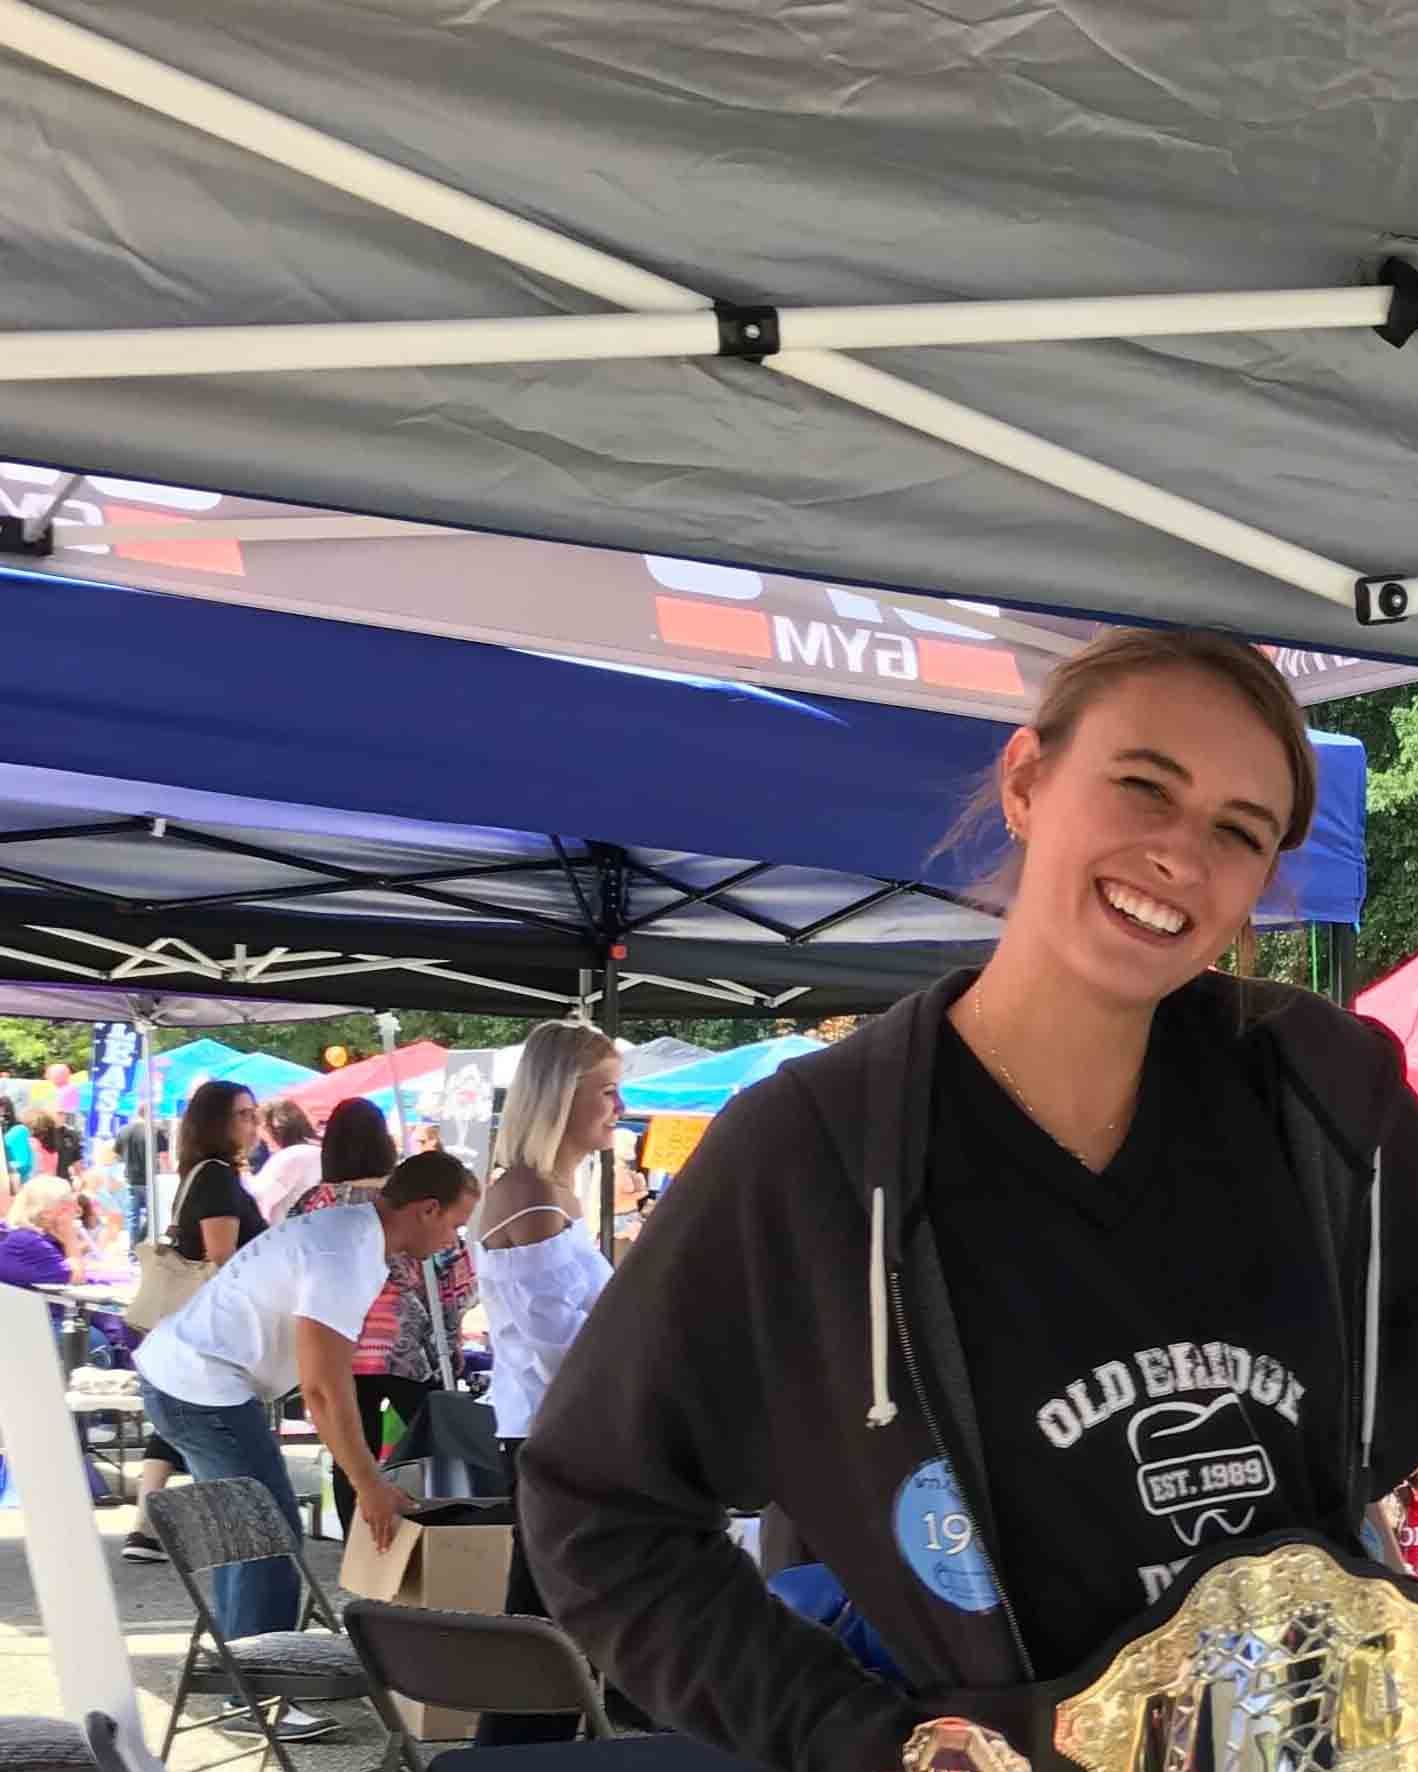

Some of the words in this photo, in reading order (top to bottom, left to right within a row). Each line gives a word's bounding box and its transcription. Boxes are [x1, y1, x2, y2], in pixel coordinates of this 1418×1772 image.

[1036, 1360, 1136, 1449] OLD
[1148, 1469, 1198, 1502] EST.
[1199, 1458, 1265, 1492] 1989
